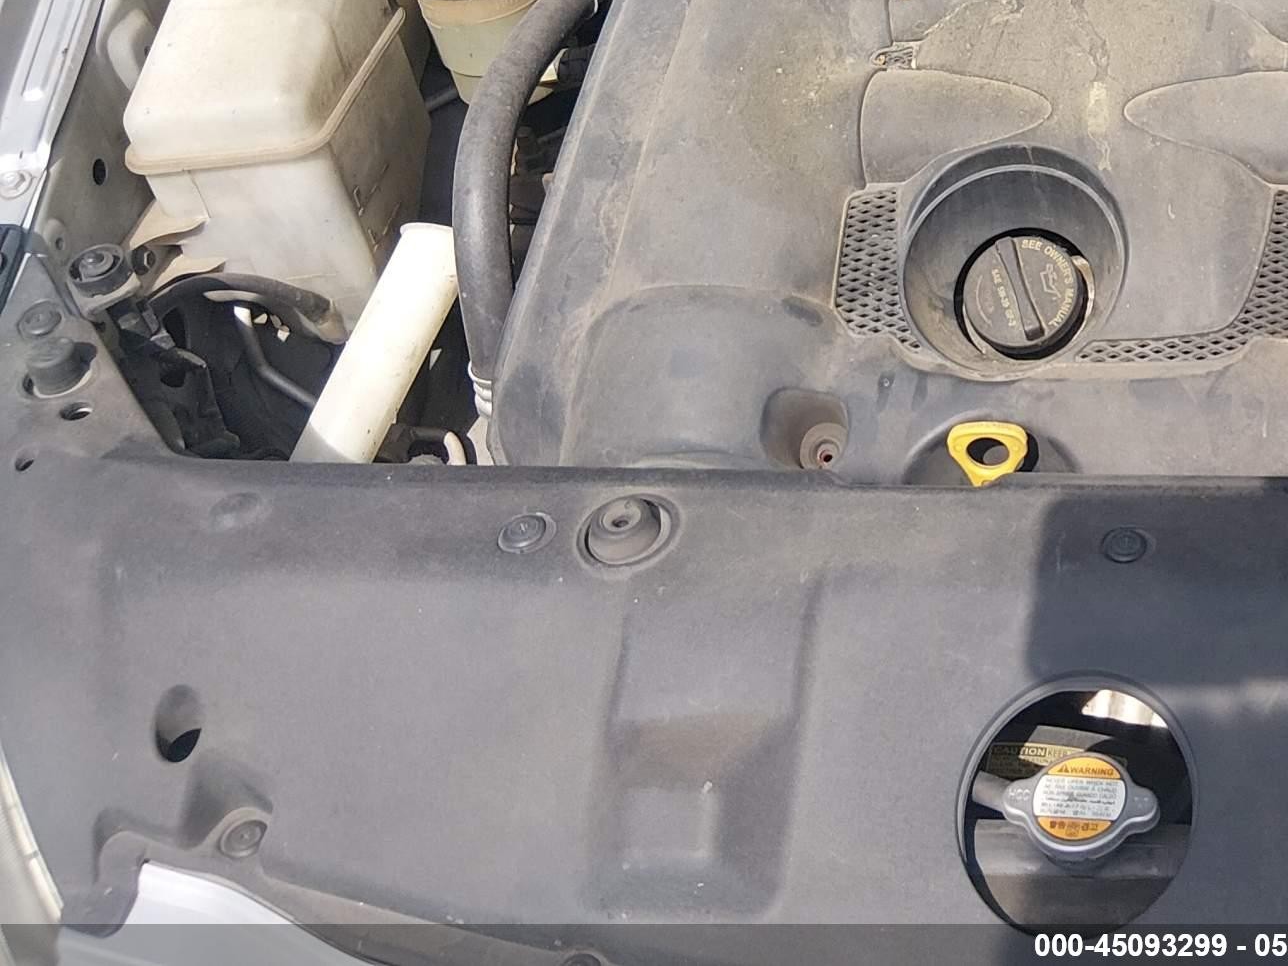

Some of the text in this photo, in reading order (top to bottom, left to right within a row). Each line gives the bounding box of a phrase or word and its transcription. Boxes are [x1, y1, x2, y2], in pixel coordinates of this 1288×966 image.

[1021, 239, 1075, 326] SEE OWNER'S MANUAL
[1070, 766, 1114, 776] WARNING
